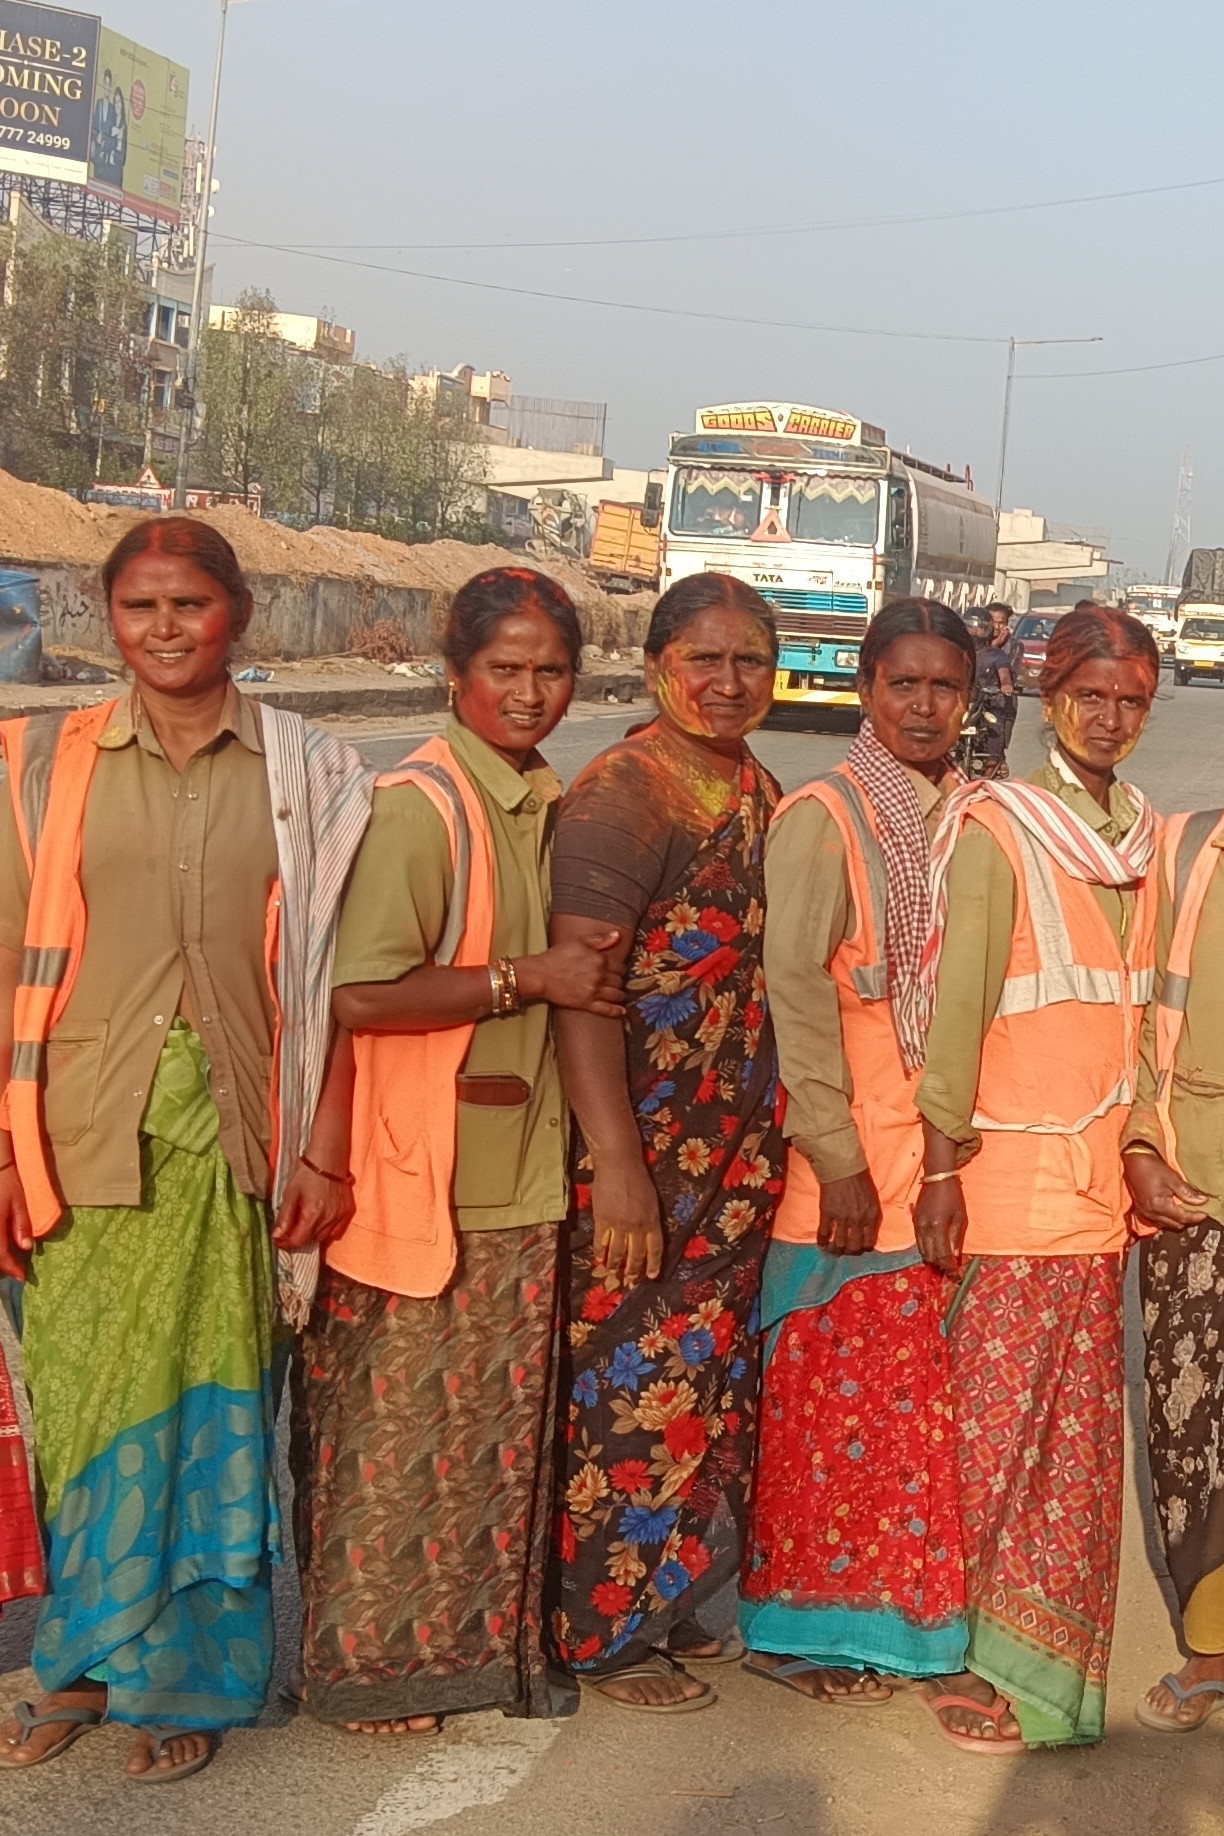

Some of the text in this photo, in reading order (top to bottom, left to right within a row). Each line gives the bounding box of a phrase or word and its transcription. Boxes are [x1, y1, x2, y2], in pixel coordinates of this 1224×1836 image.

[26, 130, 71, 150] 24999
[702, 410, 857, 440] GOODS CARRIER
[753, 573, 784, 583] TATA
